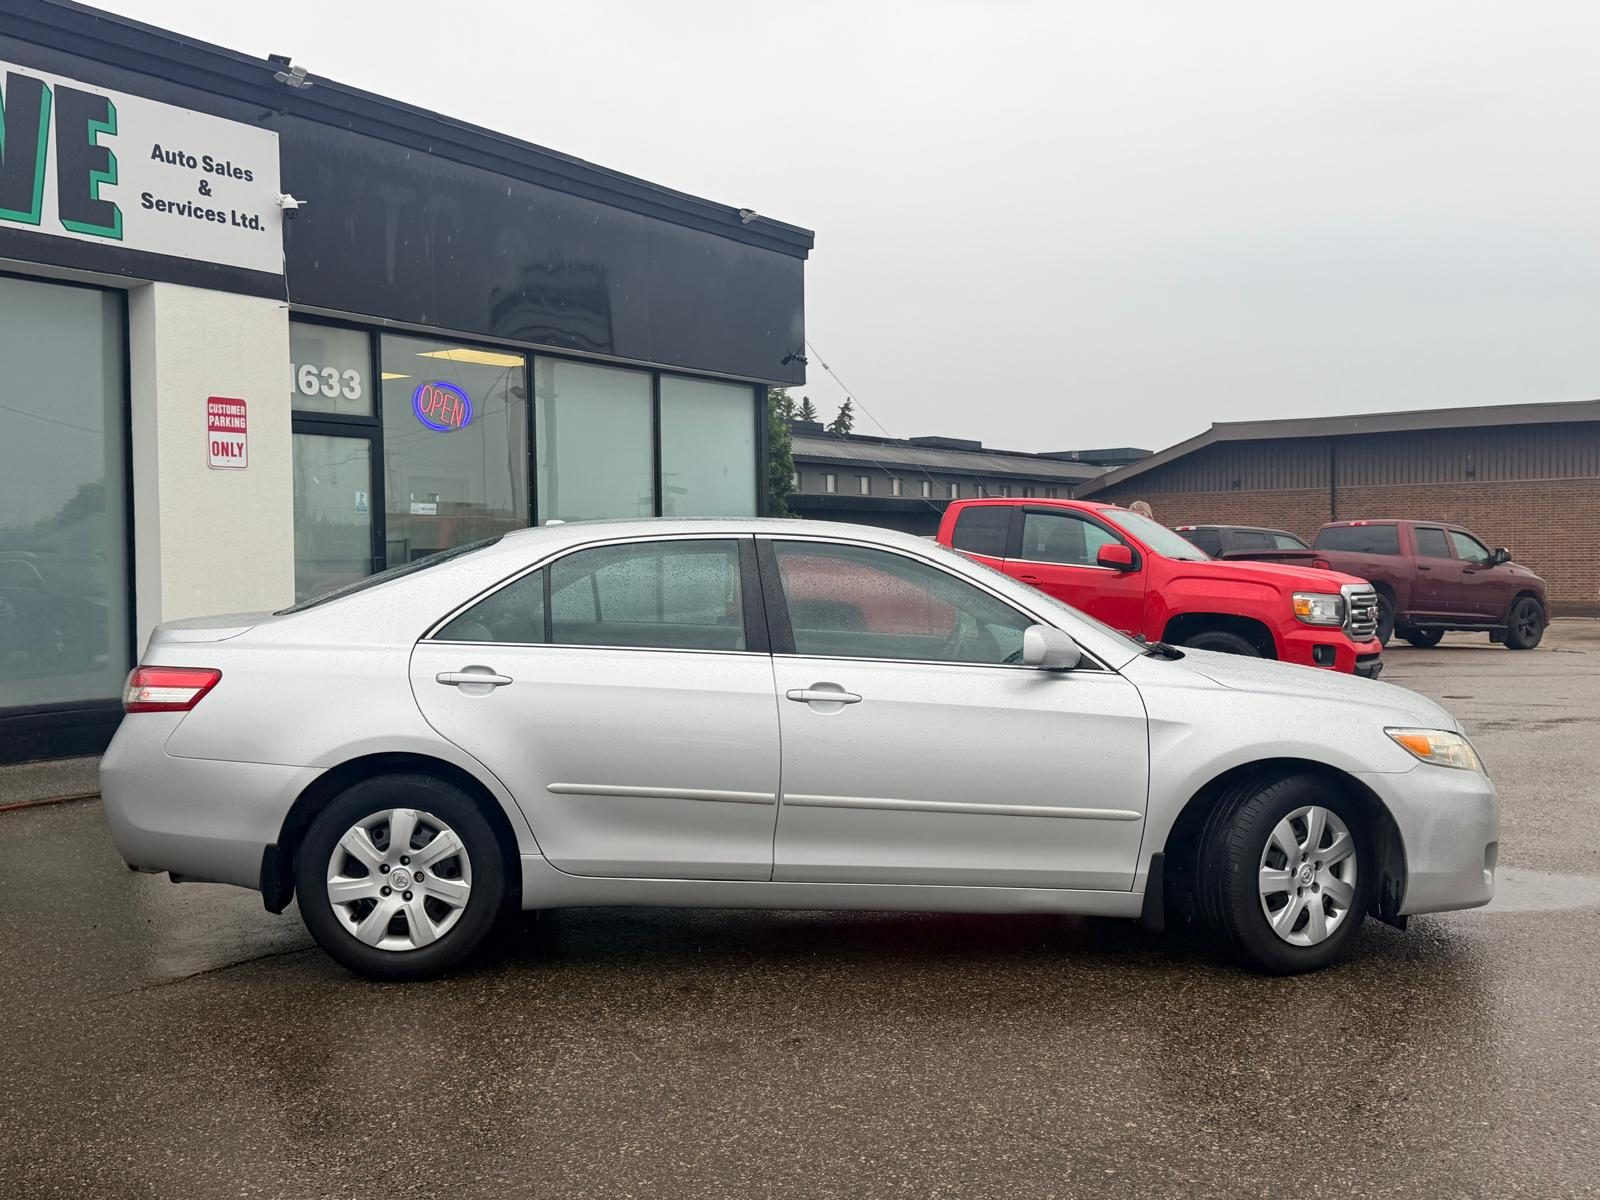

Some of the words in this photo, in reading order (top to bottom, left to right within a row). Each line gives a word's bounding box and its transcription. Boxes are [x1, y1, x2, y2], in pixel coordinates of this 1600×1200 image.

[150, 143, 198, 169] Auto
[201, 154, 254, 182] Sales
[198, 179, 212, 197] &
[140, 191, 227, 224] Services
[231, 209, 265, 231] Ltd.
[208, 403, 246, 416] CUSTOMER
[420, 384, 465, 427] OPEN
[208, 415, 246, 429] PARKING
[211, 440, 244, 458] ONLY
